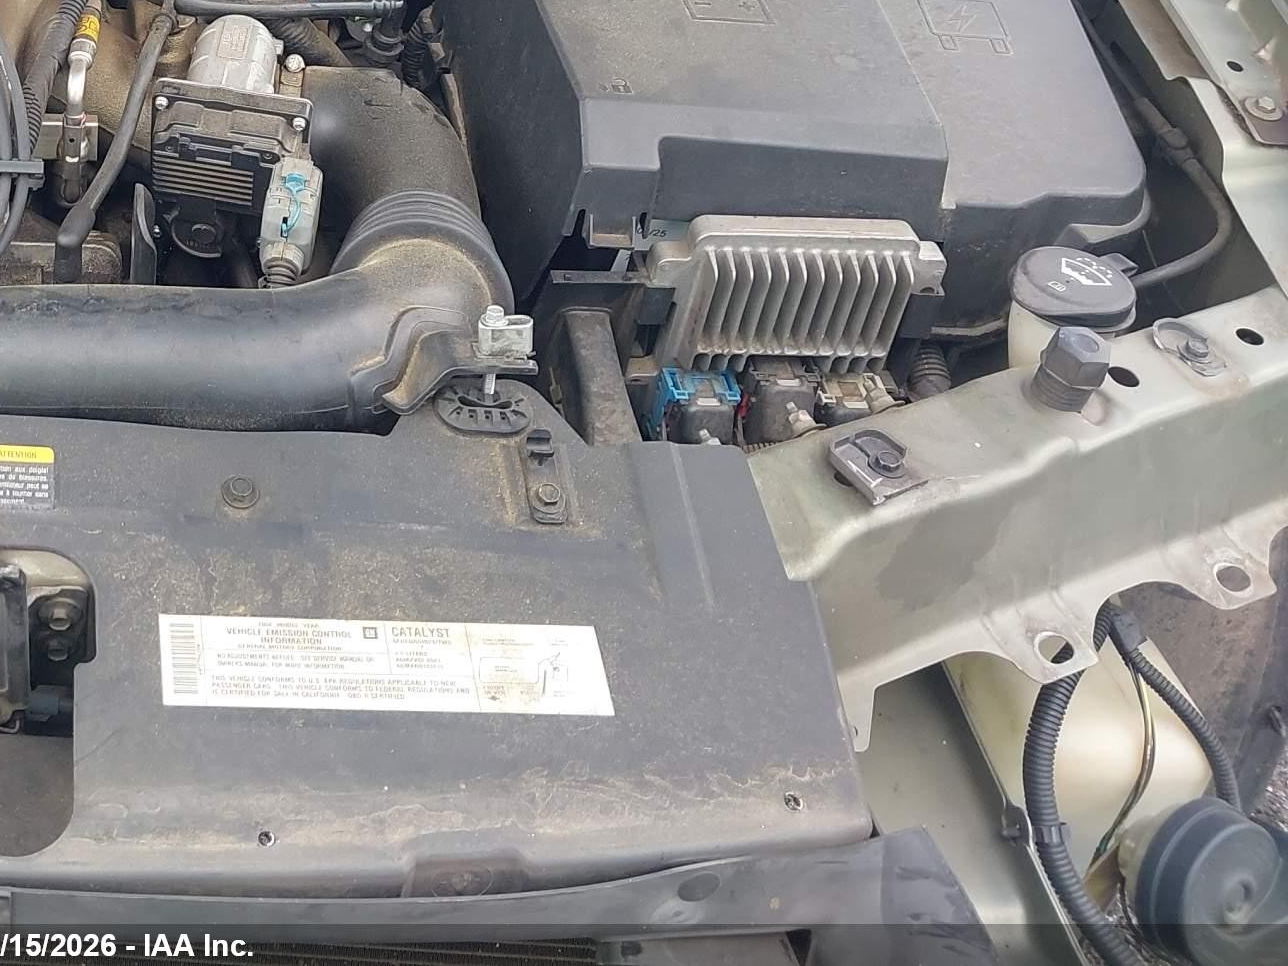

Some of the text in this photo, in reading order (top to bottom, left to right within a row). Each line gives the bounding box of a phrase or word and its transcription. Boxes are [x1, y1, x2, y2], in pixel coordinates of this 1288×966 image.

[636, 227, 666, 237] 0/25
[227, 627, 352, 639] VEHICLE EMISSION CONTROL
[392, 627, 450, 638] CATALYST
[260, 637, 322, 645] INFORMATION
